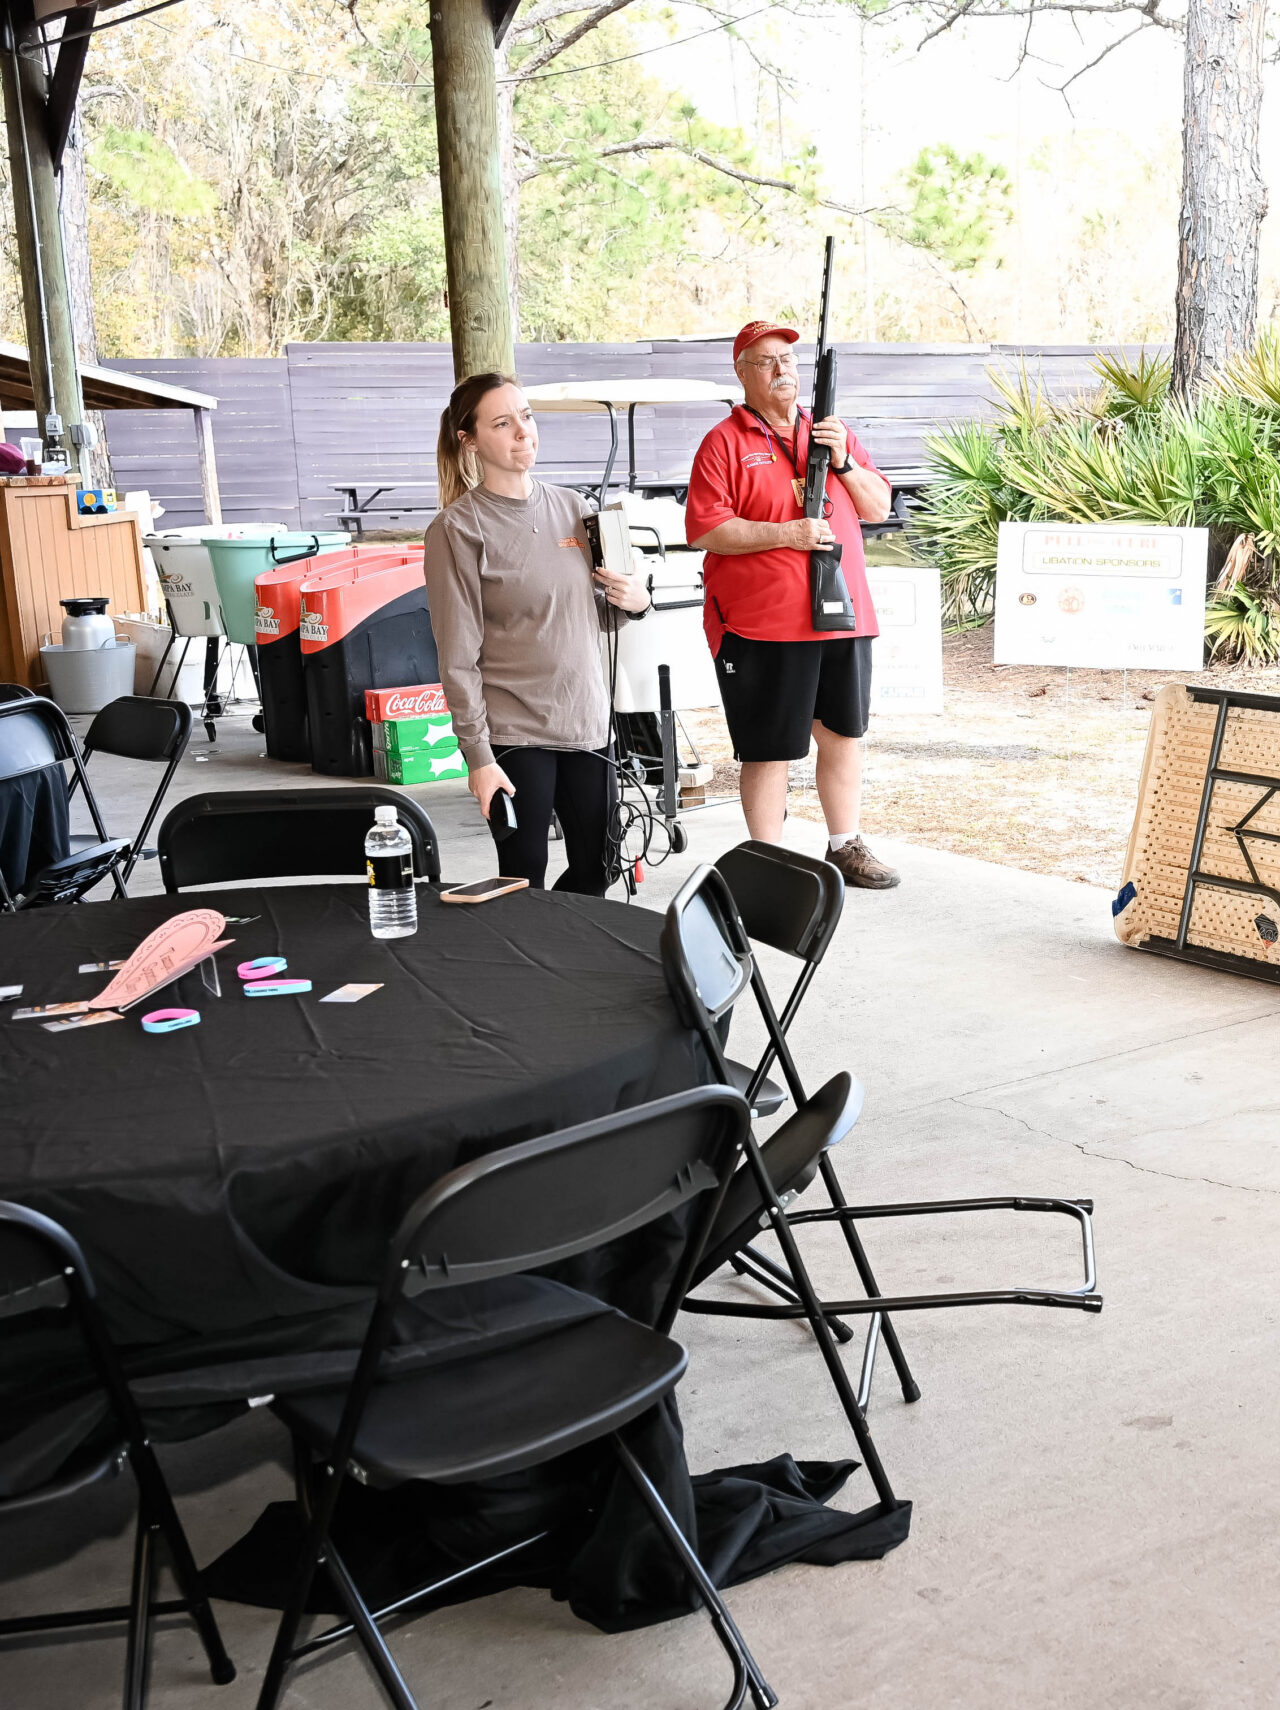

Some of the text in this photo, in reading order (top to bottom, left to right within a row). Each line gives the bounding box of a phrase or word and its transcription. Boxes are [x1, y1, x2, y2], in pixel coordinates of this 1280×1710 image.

[1042, 557, 1162, 568] LIBATION SPONSORS
[175, 582, 192, 592] BAY
[263, 619, 280, 628] BAY
[311, 625, 328, 635] BAY
[386, 690, 445, 715] Coca-Cola
